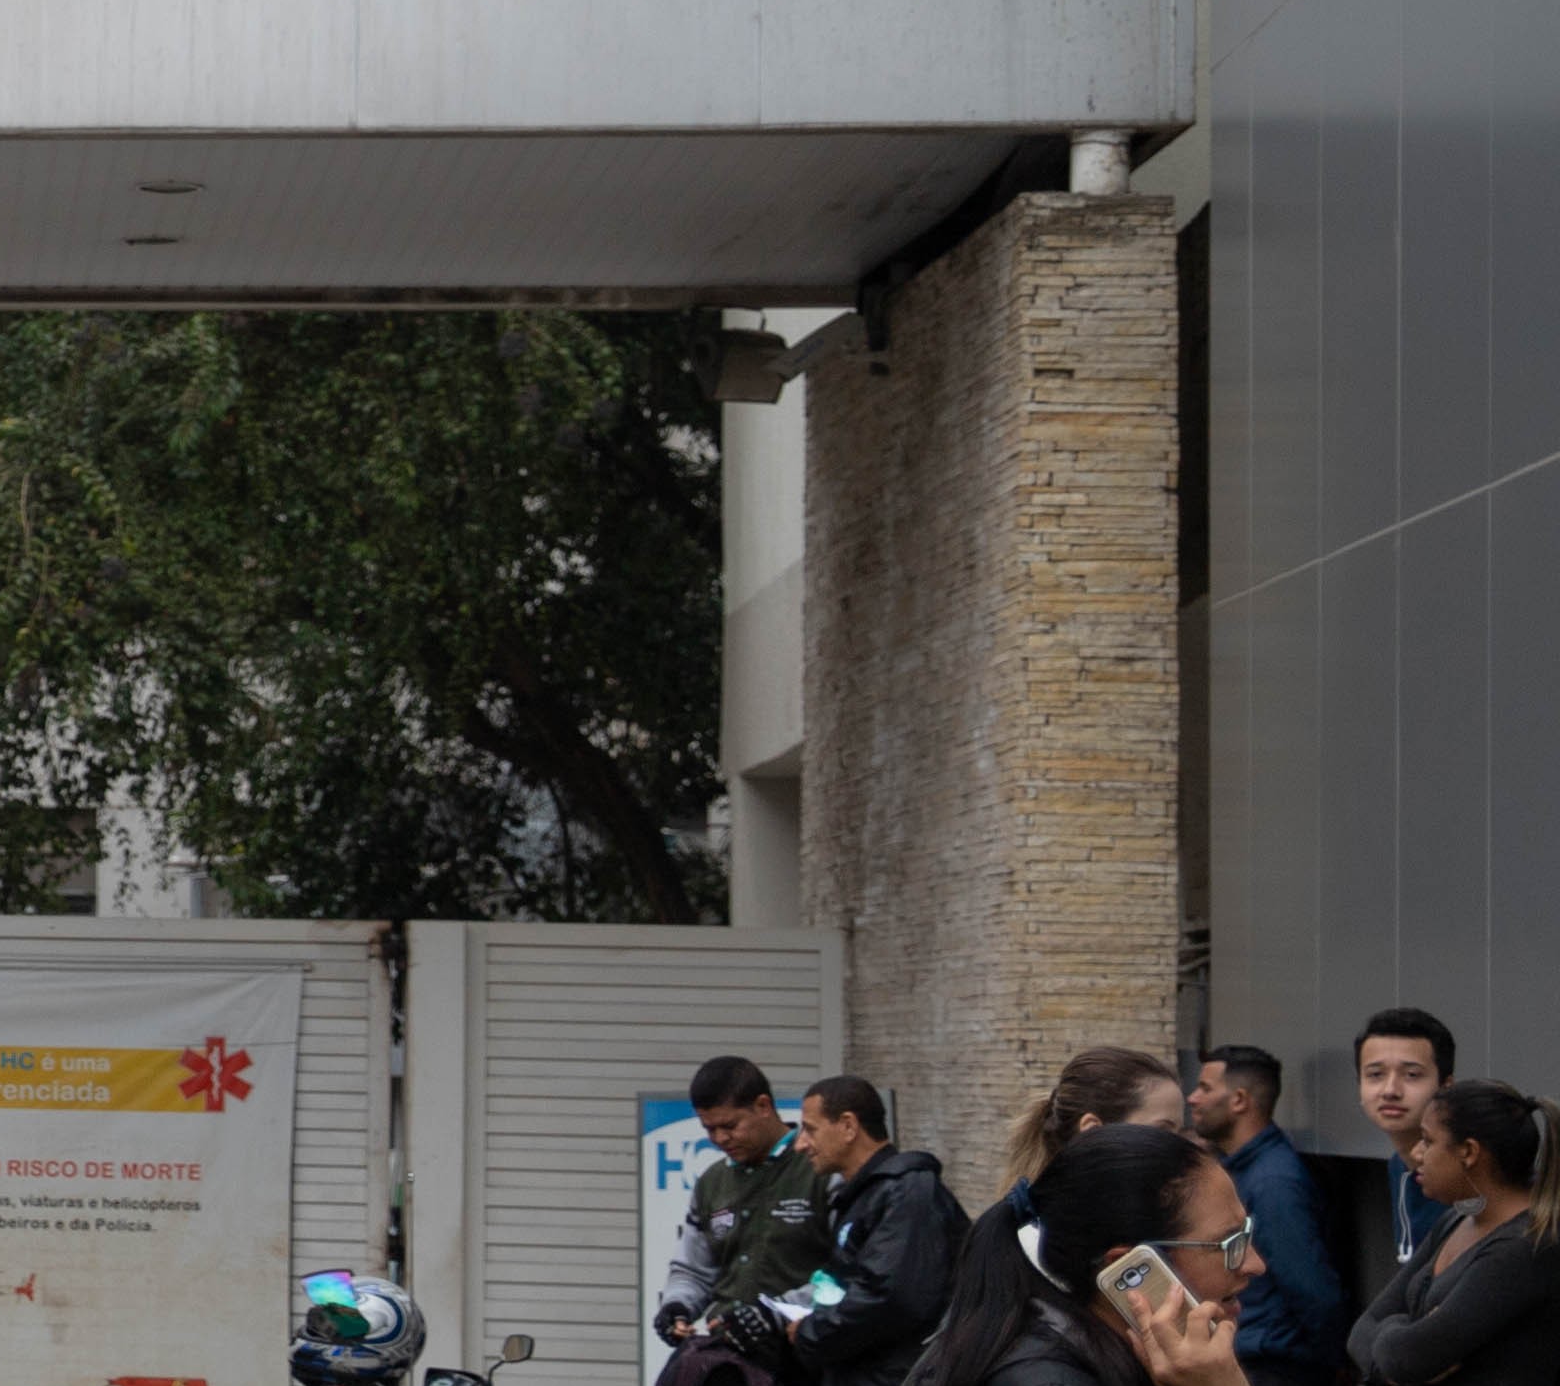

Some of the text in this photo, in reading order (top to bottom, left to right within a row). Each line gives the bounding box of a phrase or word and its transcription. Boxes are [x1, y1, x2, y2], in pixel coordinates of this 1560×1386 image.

[0, 1052, 35, 1071] HC
[41, 1051, 55, 1072] é
[61, 1056, 111, 1073] uma
[7, 1159, 78, 1179] RISCO
[84, 1161, 114, 1179] DE
[121, 1162, 202, 1181] MORTE
[87, 1199, 97, 1210] e
[55, 1220, 64, 1231] e
[69, 1217, 90, 1232] da
